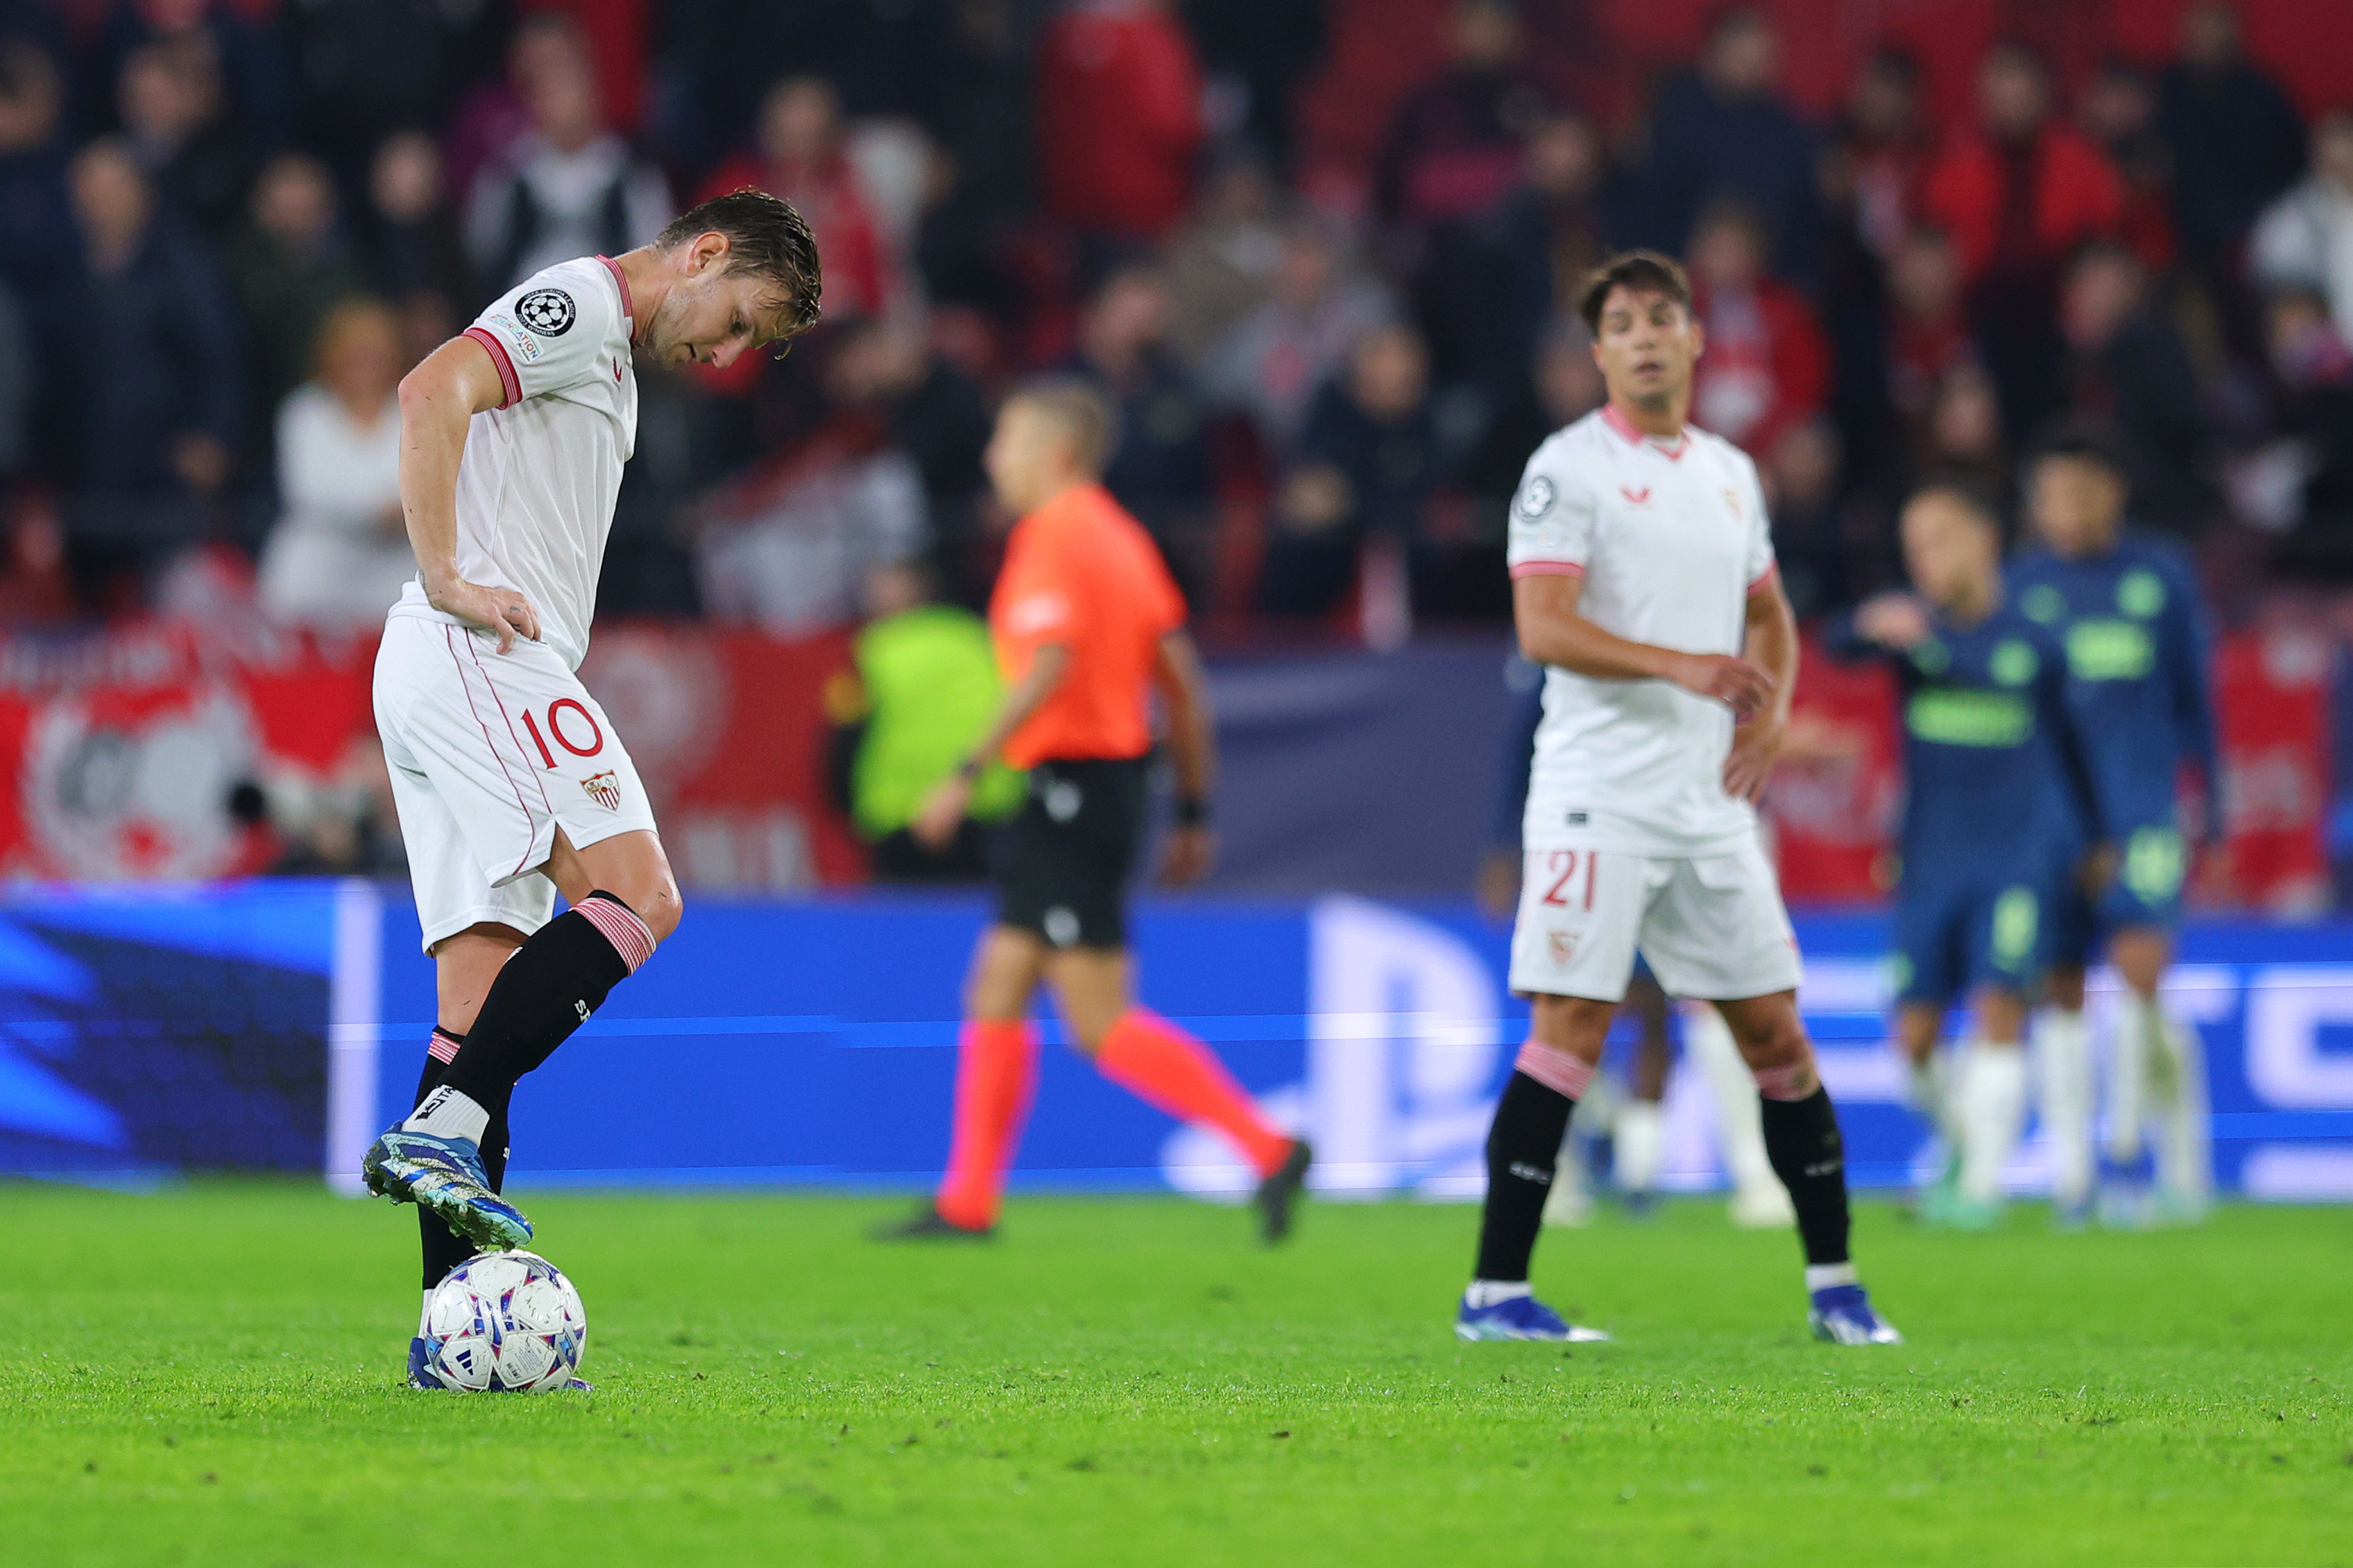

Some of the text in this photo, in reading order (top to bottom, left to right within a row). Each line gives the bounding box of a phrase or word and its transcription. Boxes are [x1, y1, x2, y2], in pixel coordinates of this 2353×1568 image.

[524, 289, 540, 300] UEFA
[564, 296, 575, 319] LEAGUE
[490, 315, 538, 359] FOUNDATION
[527, 325, 556, 336] WINNERS
[521, 698, 604, 770] 10
[1542, 850, 1598, 913] 21
